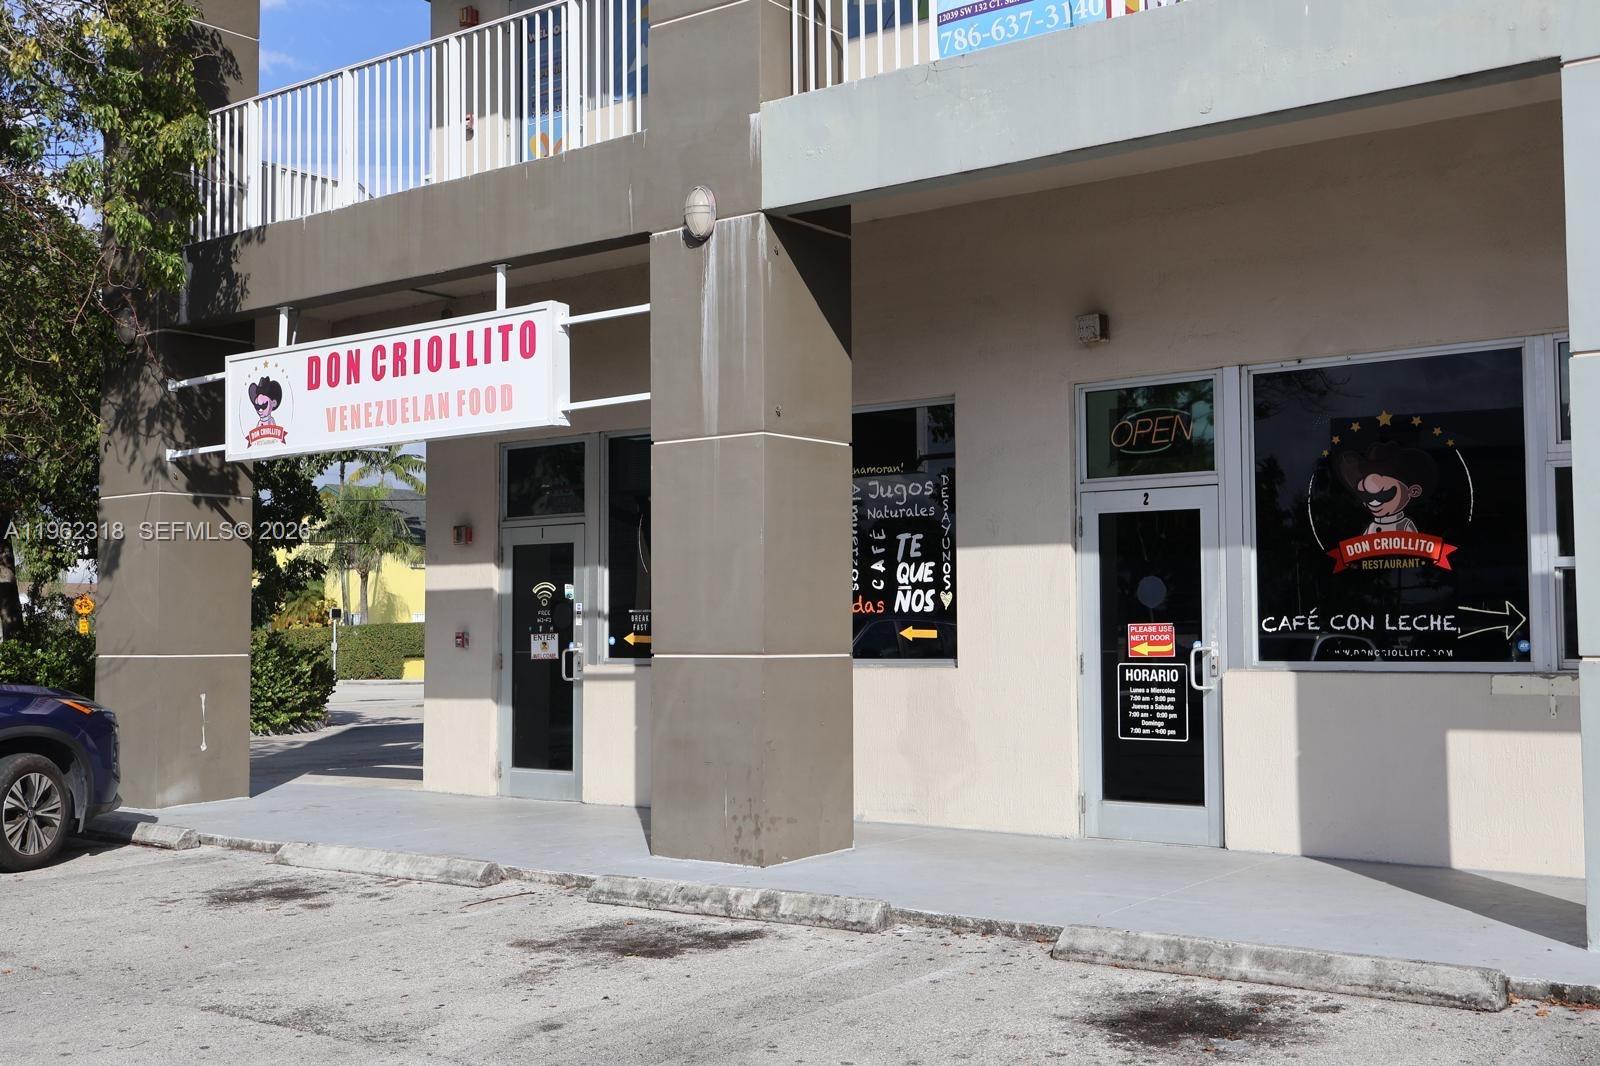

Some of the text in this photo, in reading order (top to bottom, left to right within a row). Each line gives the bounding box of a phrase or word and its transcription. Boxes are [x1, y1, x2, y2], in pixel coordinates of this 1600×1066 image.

[939, 10, 958, 23] 12039
[959, 6, 973, 17] SW
[974, 2, 987, 13] 132
[307, 320, 537, 391] DON CRIOLLITO
[325, 383, 513, 433] VENEZUELAN FOOD
[1111, 415, 1193, 447] OPEN
[852, 462, 904, 475] namoran!
[868, 480, 934, 505] Jugos
[1143, 492, 1150, 506] 2
[867, 503, 935, 519] Naturales
[941, 474, 952, 590] DESAYUNOS
[896, 532, 924, 562] TE
[1345, 537, 1435, 557] DON CRIOLLITO
[896, 561, 936, 585] QUE
[1362, 558, 1420, 570] RESTAURANT
[631, 614, 649, 622] BREAK
[632, 623, 648, 631] FAST
[1261, 606, 1320, 632] CAFÉ
[1330, 614, 1375, 631] CON
[1158, 625, 1173, 633] USE
[1125, 669, 1179, 682] HORARIO
[1141, 720, 1165, 728] Domingo
